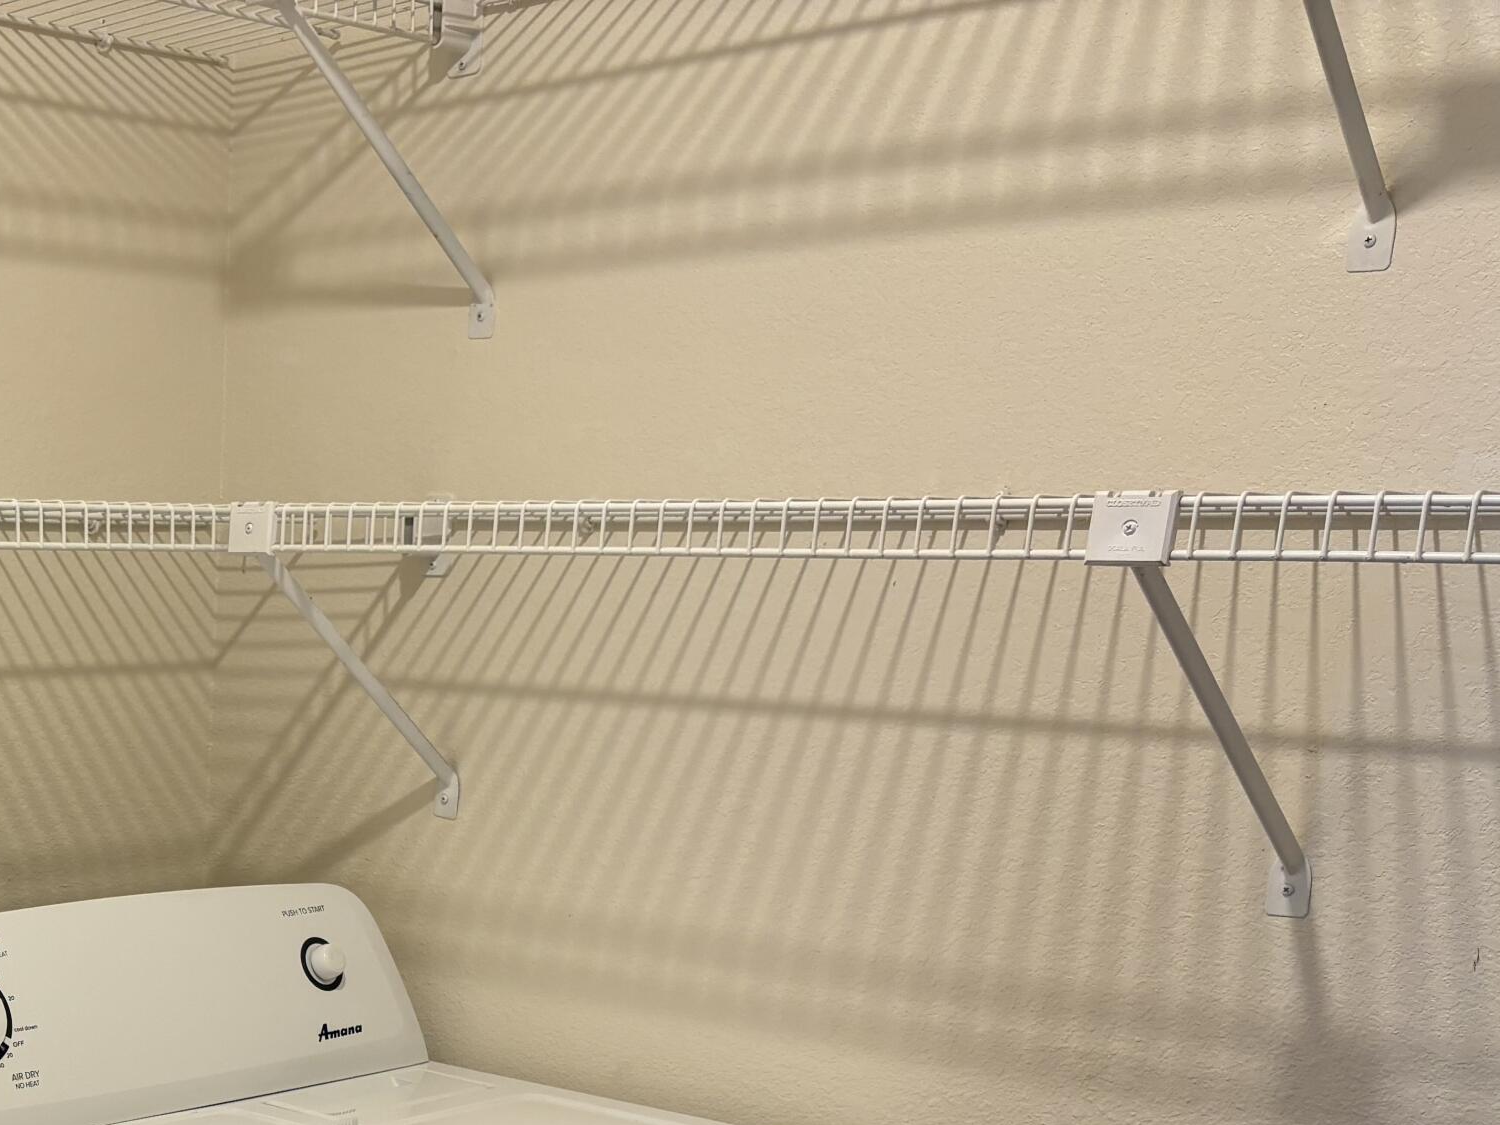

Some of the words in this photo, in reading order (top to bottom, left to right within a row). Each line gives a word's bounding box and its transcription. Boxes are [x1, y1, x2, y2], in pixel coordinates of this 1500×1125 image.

[282, 908, 298, 917] PUSH
[298, 907, 307, 915] TO
[307, 904, 325, 914] START
[318, 1023, 362, 1042] Amana
[12, 1073, 23, 1081] AIR
[25, 1070, 40, 1079] DRY
[26, 1080, 40, 1088] HEAT
